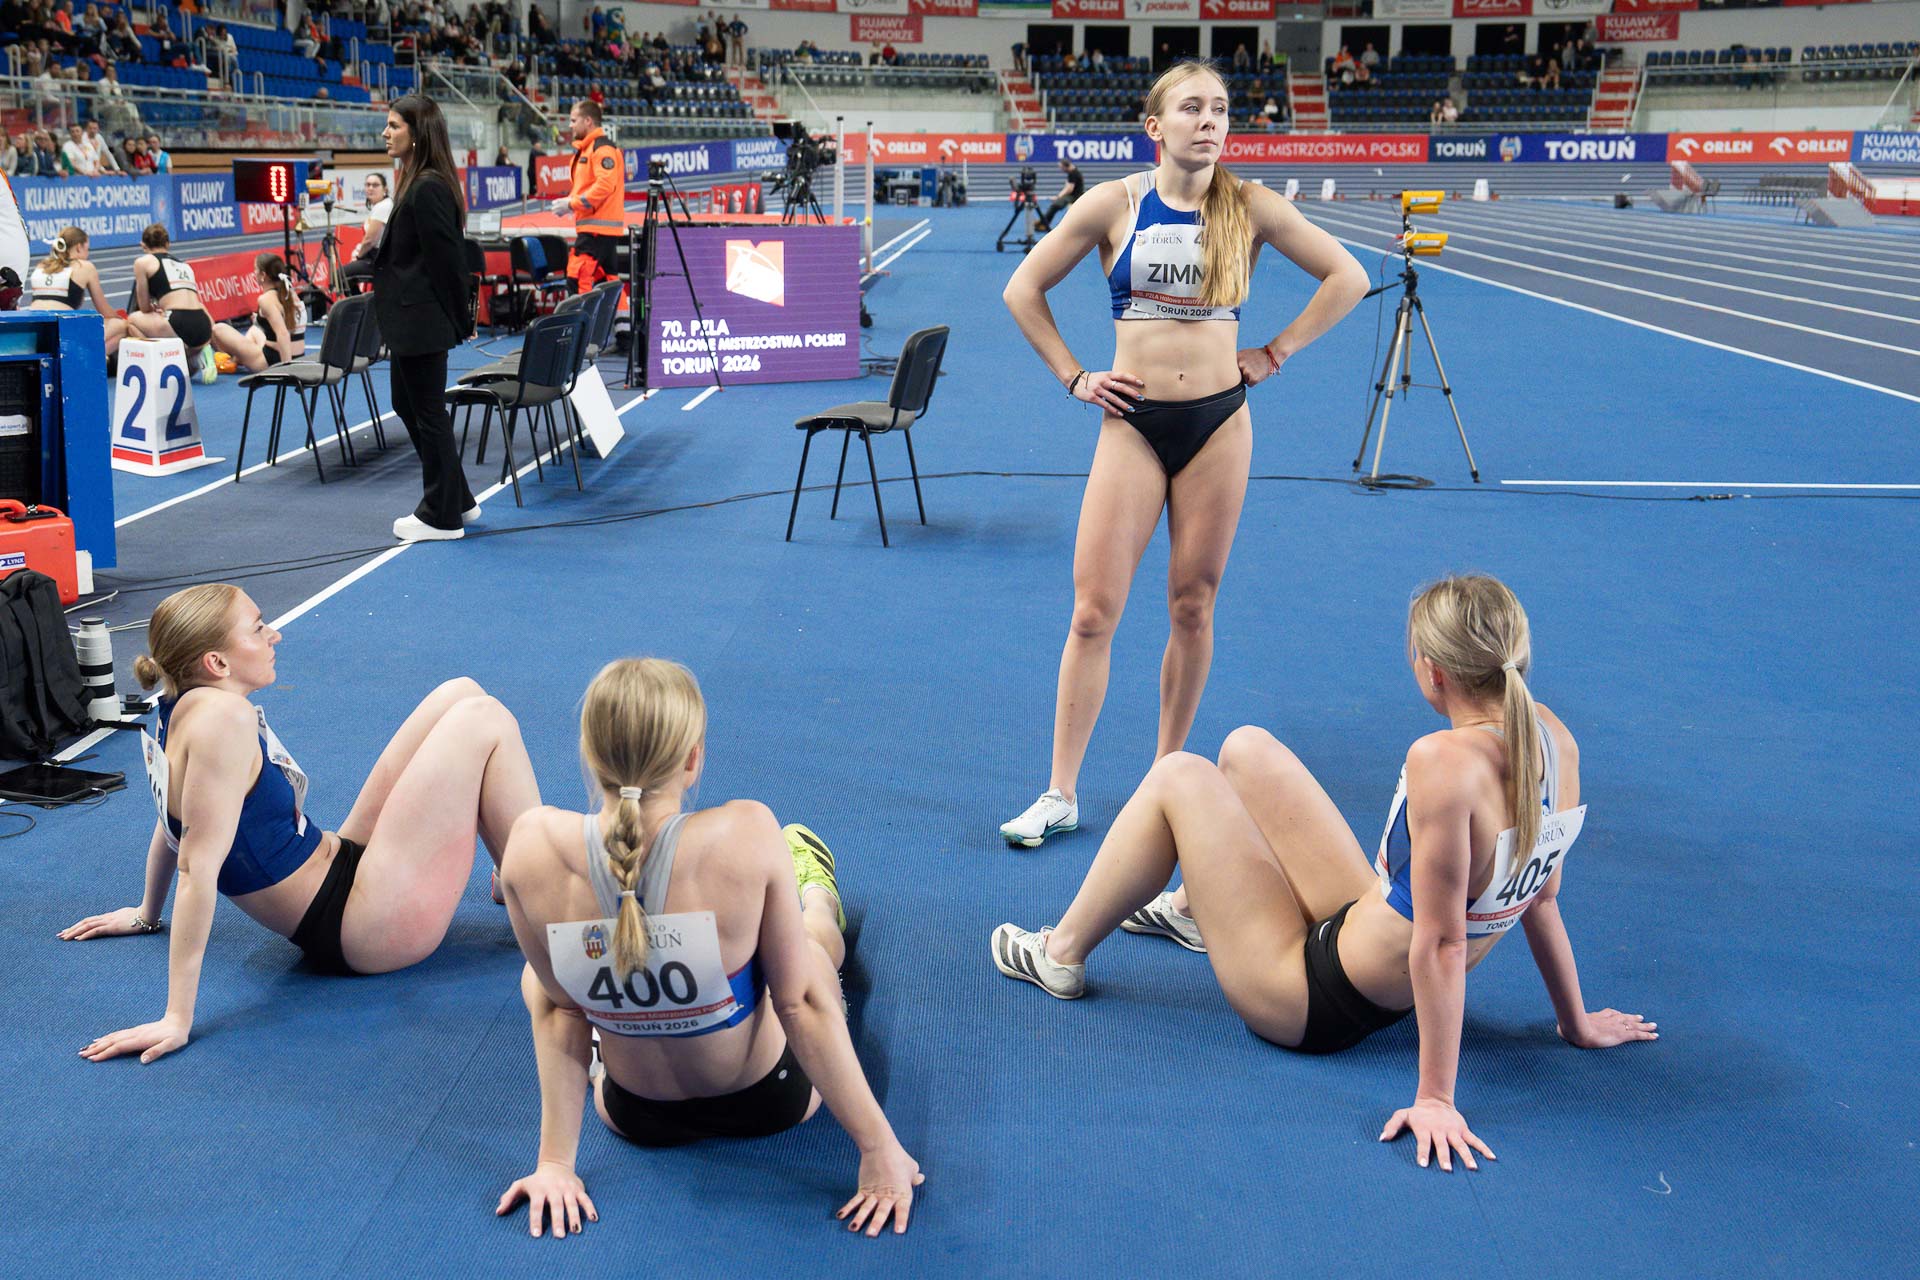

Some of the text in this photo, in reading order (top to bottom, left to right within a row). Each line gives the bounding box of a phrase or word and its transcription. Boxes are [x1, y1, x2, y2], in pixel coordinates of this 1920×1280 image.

[1079, 0, 1119, 11] ORLEN
[1227, 0, 1269, 11] ORLEN
[859, 17, 904, 28] KUJAWY
[1604, 16, 1659, 28] KUJAWY
[859, 29, 913, 41] POMORZE
[1603, 27, 1668, 40] POMORZE
[736, 140, 778, 154] KUJAWY
[887, 141, 927, 155] ORLEN
[961, 140, 1001, 155] ORLEN
[1053, 137, 1133, 160] TORUŃ
[1224, 141, 1420, 157] LOWE MISTRZOSTWA POLSKI
[1436, 138, 1486, 157] TORUŃ
[1545, 136, 1636, 161] TORUŃ
[1703, 140, 1753, 154] ORLEN
[1797, 139, 1848, 153] ORLEN
[736, 153, 787, 169] POMORZE
[180, 181, 225, 205] KUJAWY
[270, 165, 287, 202] 0
[486, 170, 516, 202] TORUŃ
[25, 184, 151, 211] KUJAWSKO-POMORSKI
[182, 206, 235, 232] POMORZE
[247, 202, 295, 226] POMORE
[199, 276, 243, 303] HALOWE
[1156, 304, 1213, 317] TORUŃ 2026
[661, 318, 730, 338] 70. PZLA
[661, 333, 847, 353] HALOWE MISTRZOSTWA POLSKI
[662, 352, 761, 375] TORUŃ 2026
[121, 364, 147, 442] 2
[160, 364, 193, 442] 2
[7, 556, 25, 565] LYNX
[1537, 823, 1566, 847] ORUŃ
[1496, 849, 1561, 907] 405
[587, 961, 699, 1009] 400
[614, 1021, 699, 1032] TORUŃ 2026
